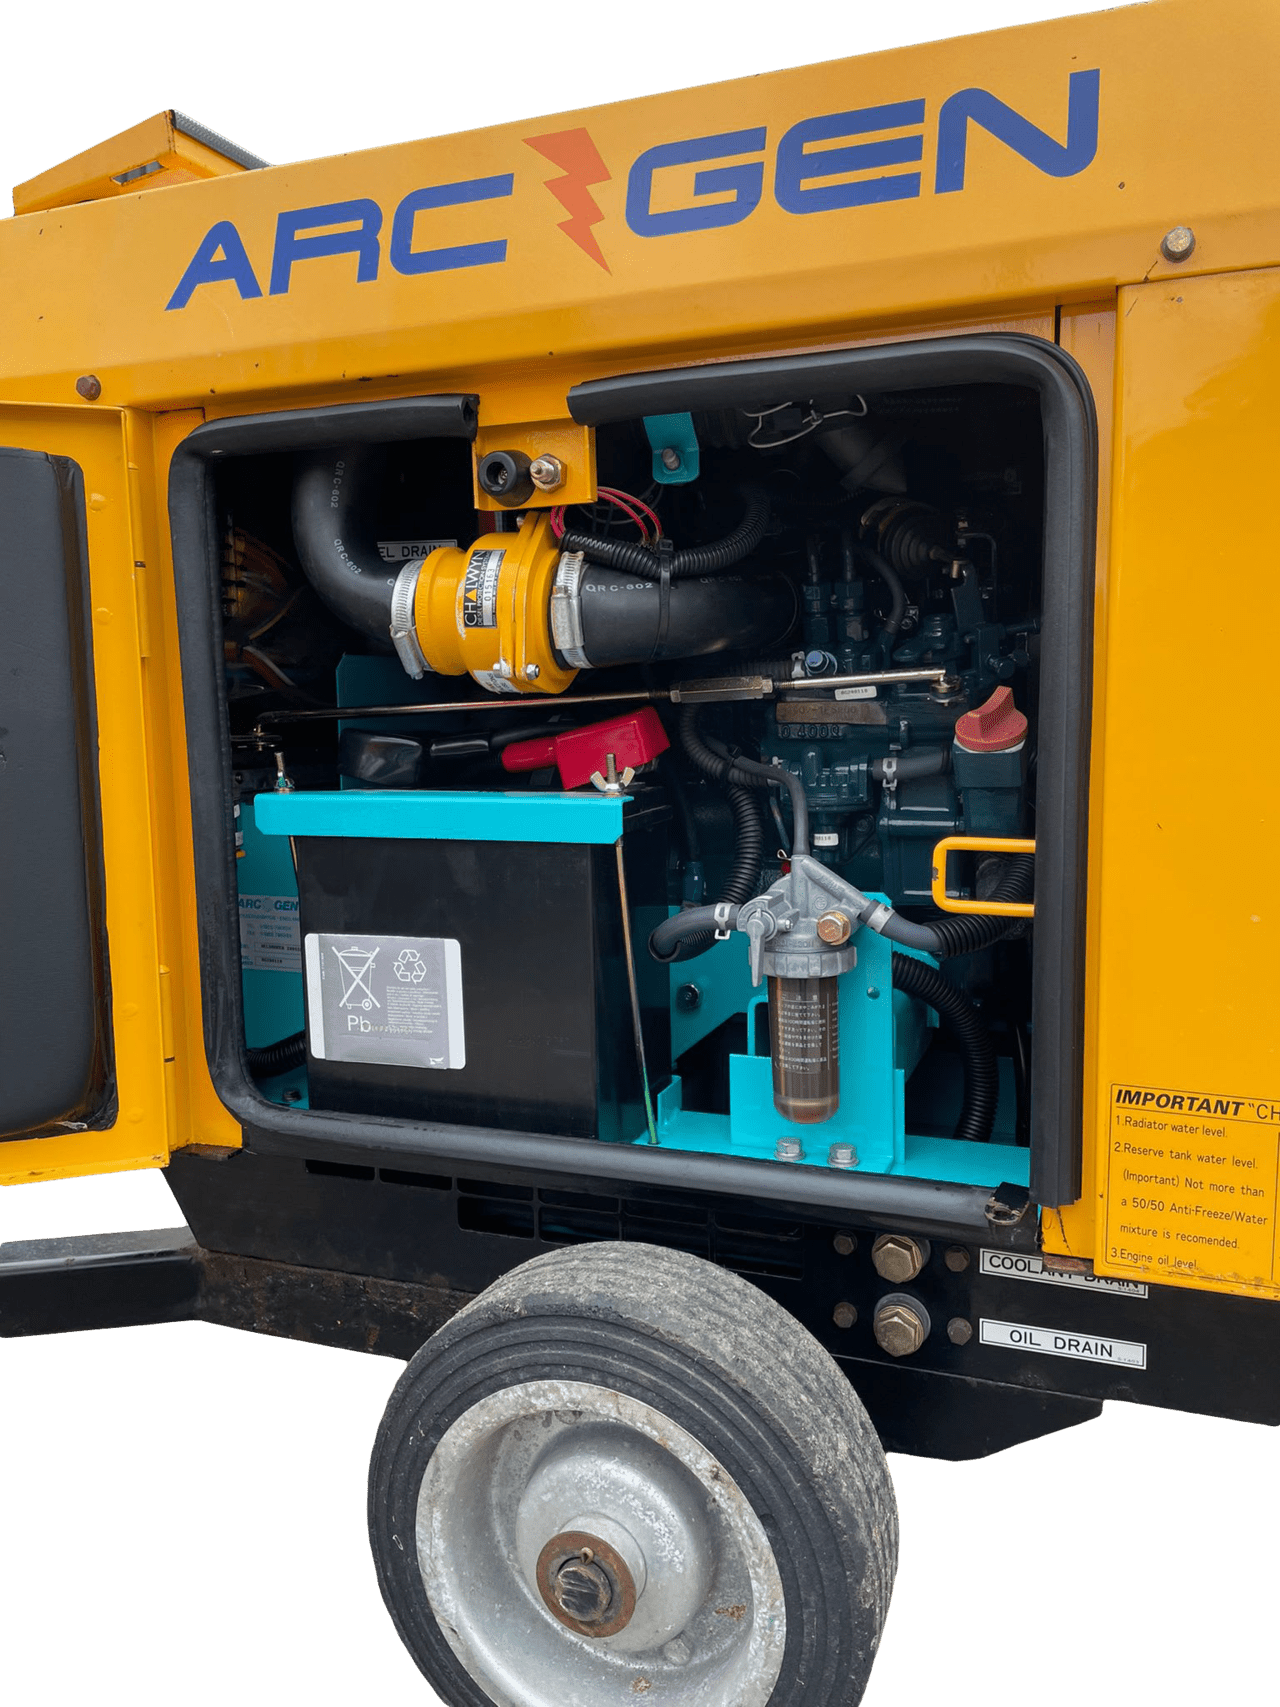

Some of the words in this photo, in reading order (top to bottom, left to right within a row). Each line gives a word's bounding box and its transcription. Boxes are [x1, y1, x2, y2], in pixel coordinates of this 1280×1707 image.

[165, 173, 514, 311] ARC
[626, 69, 1100, 238] GEN
[347, 1015, 372, 1033] Pb
[1115, 1089, 1245, 1116] IMPORTANT
[1171, 1124, 1200, 1134] water
[1169, 1149, 1192, 1161] tank
[1197, 1153, 1227, 1165] water
[1232, 1155, 1258, 1169] level.
[1123, 1168, 1180, 1188] (Important)
[1184, 1177, 1204, 1190] Not
[1209, 1182, 1235, 1194] more
[1240, 1185, 1265, 1197] than
[1120, 1197, 1127, 1207] a
[1132, 1197, 1165, 1212] 50/50
[1169, 1203, 1268, 1226] Anti-Freeze/Water
[1120, 1222, 1158, 1238] mixture
[1162, 1227, 1171, 1239] is
[1175, 1231, 1240, 1249] recomended.
[989, 1254, 1073, 1279] COOL
[1157, 1254, 1169, 1266] oil
[1009, 1329, 1042, 1347] OIL
[1053, 1336, 1113, 1358] DRAIN
